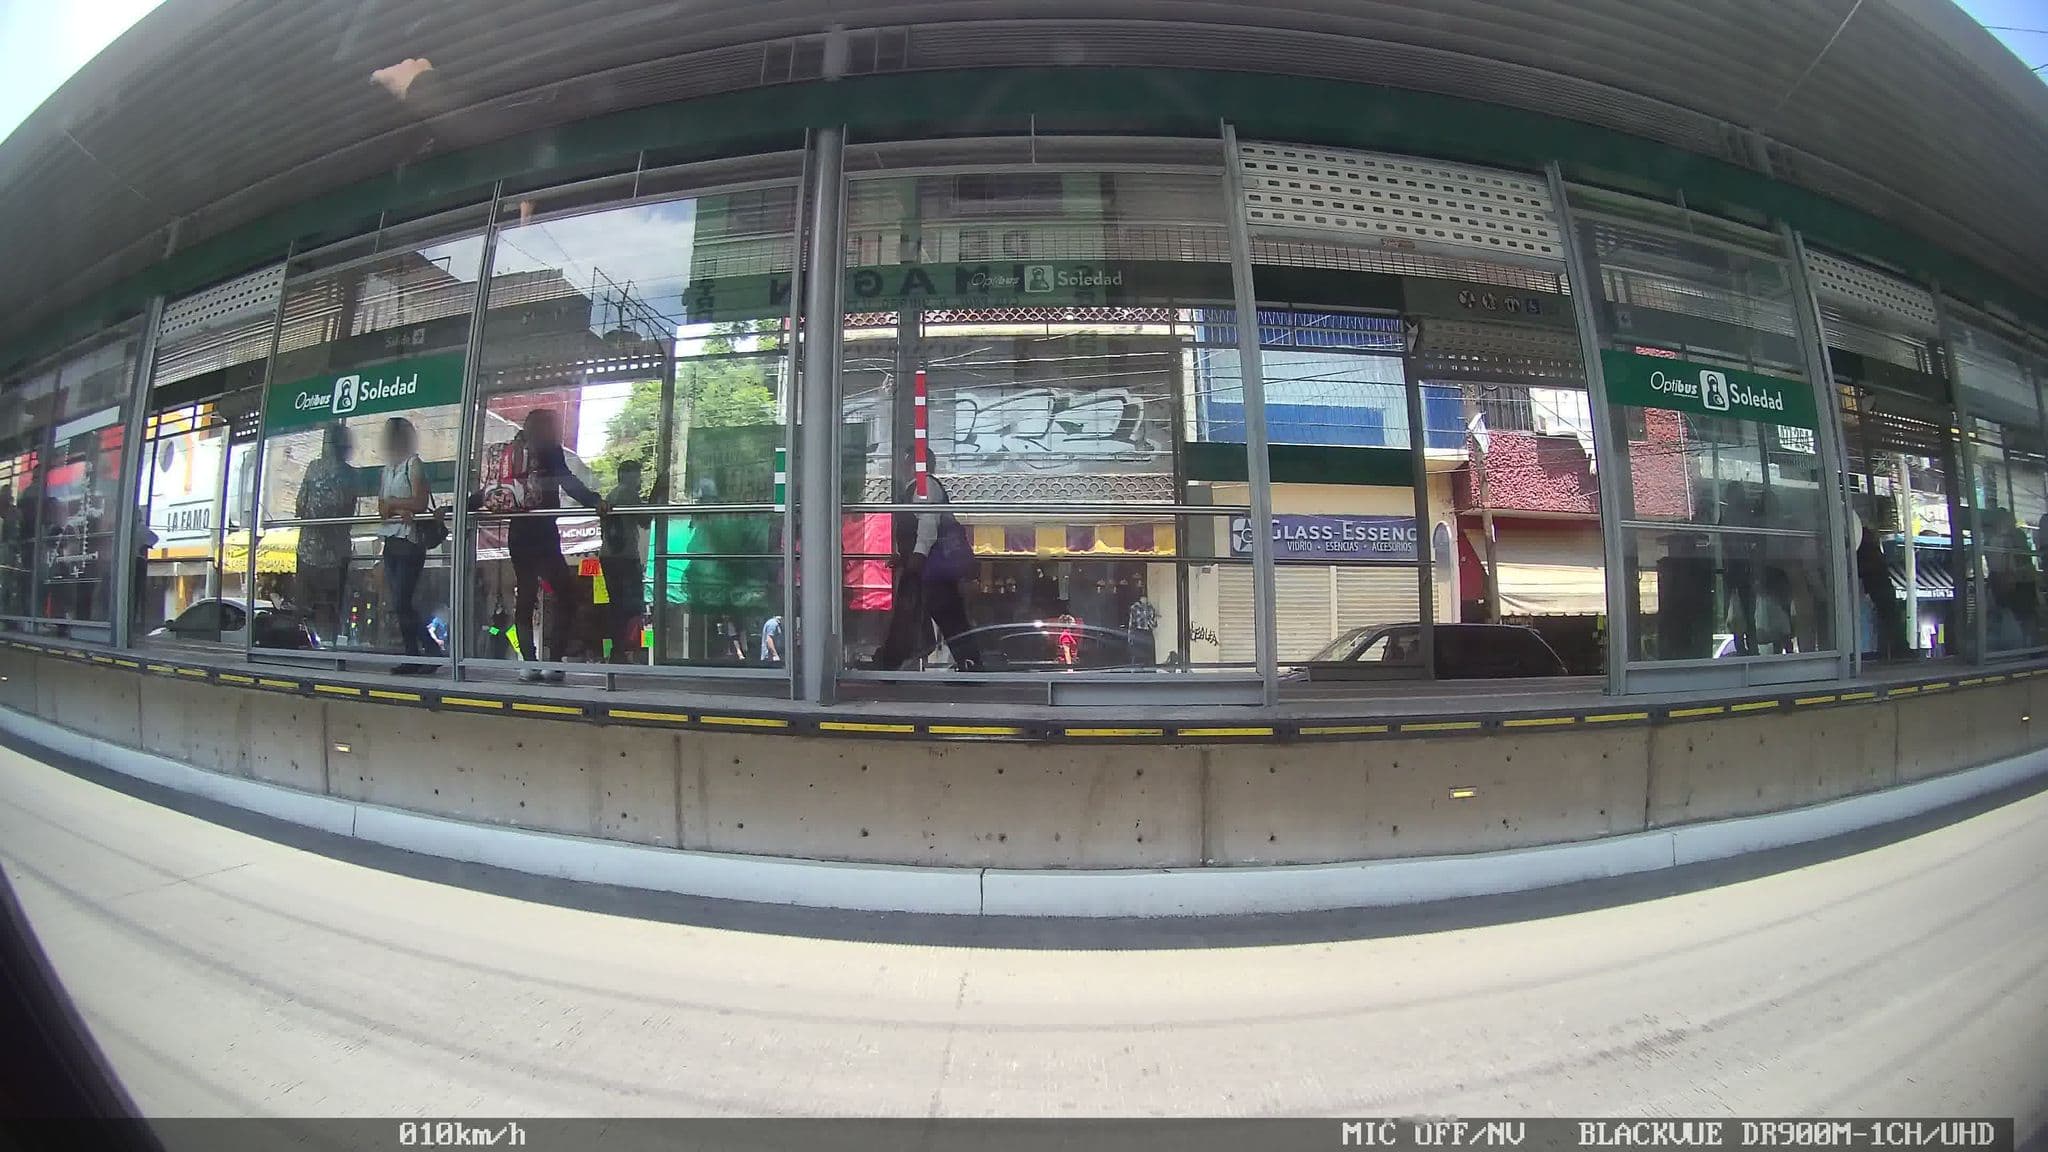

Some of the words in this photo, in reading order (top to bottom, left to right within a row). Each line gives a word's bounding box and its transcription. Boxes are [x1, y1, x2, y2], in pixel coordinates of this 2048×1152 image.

[1057, 270, 1122, 286] Soledad
[295, 391, 332, 410] Optibus
[360, 373, 418, 401] Soledad
[1650, 371, 1698, 397] Optibus
[1729, 383, 1784, 411] Soledad
[1325, 541, 1359, 551] ESENCIAS
[1372, 541, 1412, 552] ACCESORIOS
